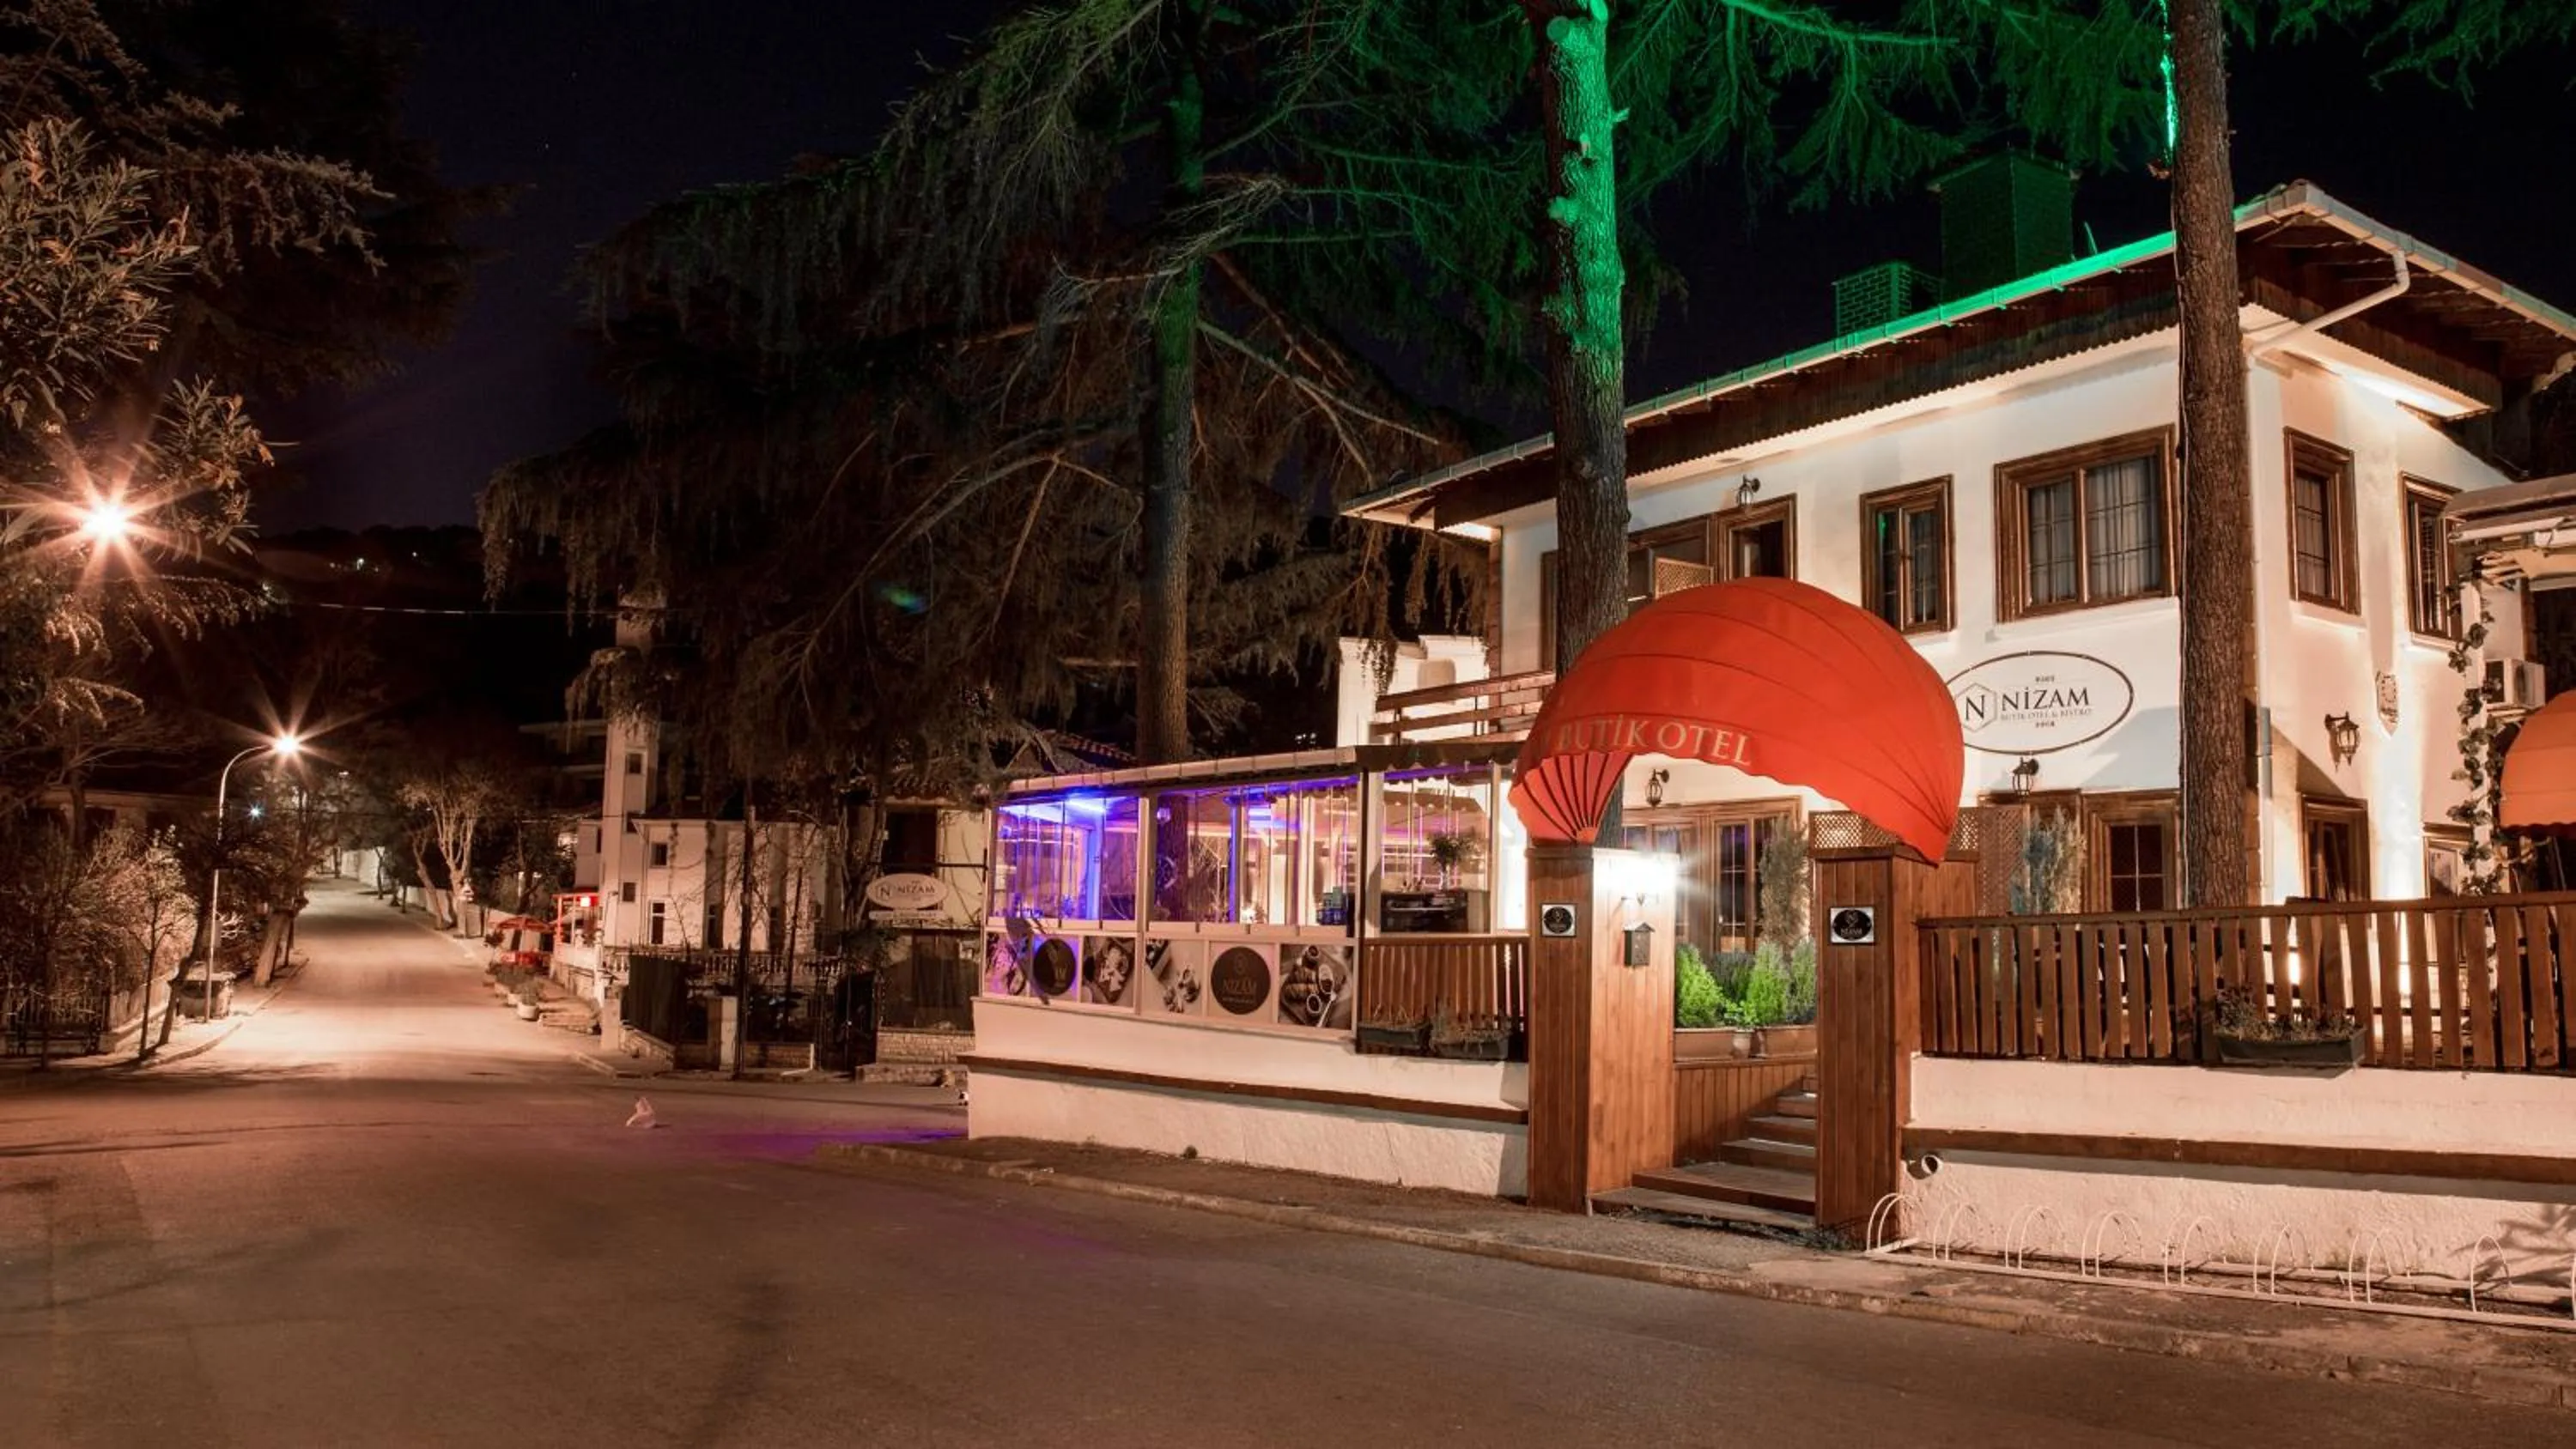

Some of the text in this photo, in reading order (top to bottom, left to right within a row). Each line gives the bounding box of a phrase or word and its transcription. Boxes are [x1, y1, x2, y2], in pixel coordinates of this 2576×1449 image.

[1965, 687, 2089, 720] N NİZAM
[1657, 722, 1751, 766] OTEL
